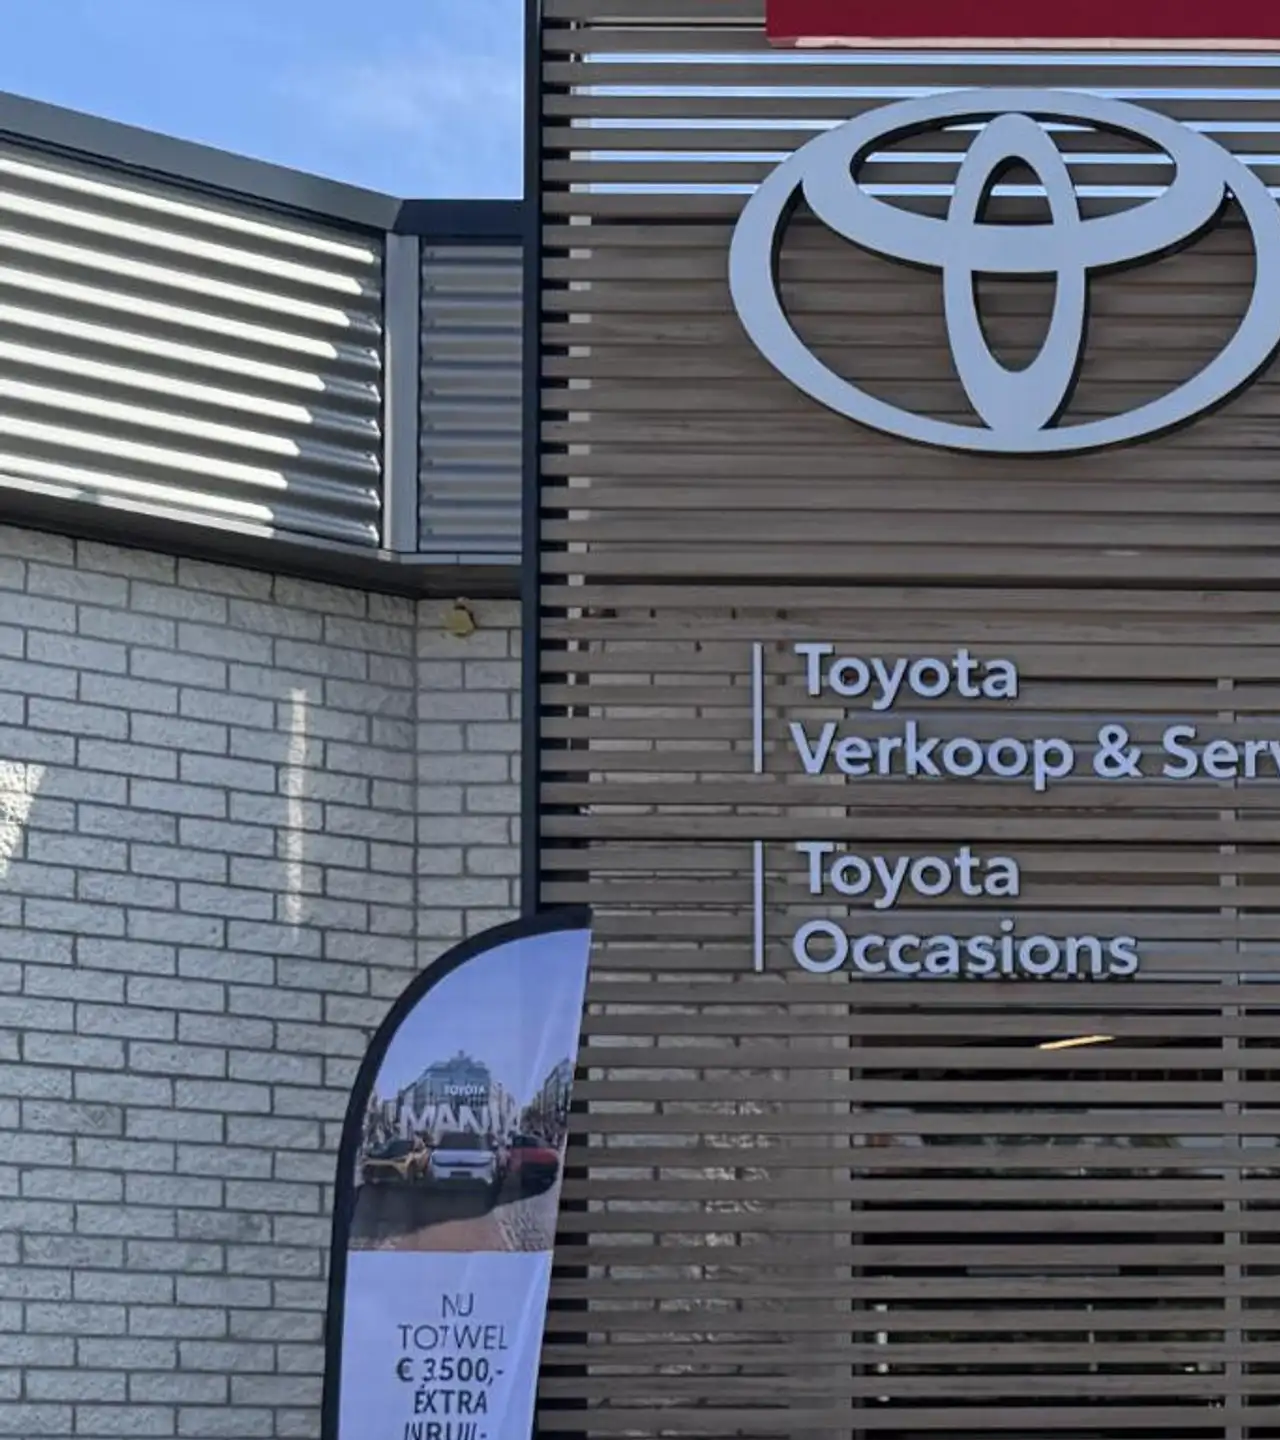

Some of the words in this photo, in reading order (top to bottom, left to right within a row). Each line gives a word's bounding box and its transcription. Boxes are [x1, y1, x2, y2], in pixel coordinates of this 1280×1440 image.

[795, 643, 1019, 710] Toyota
[790, 721, 1075, 790] Verkoop
[1093, 724, 1142, 779] &
[796, 843, 1020, 909] Toyota
[792, 920, 1140, 976] Occasions
[443, 1084, 487, 1098] TOYOTA
[400, 1103, 521, 1140] MANIA
[442, 1292, 474, 1319] NU
[397, 1324, 449, 1351] TOT
[453, 1325, 508, 1350] WEL
